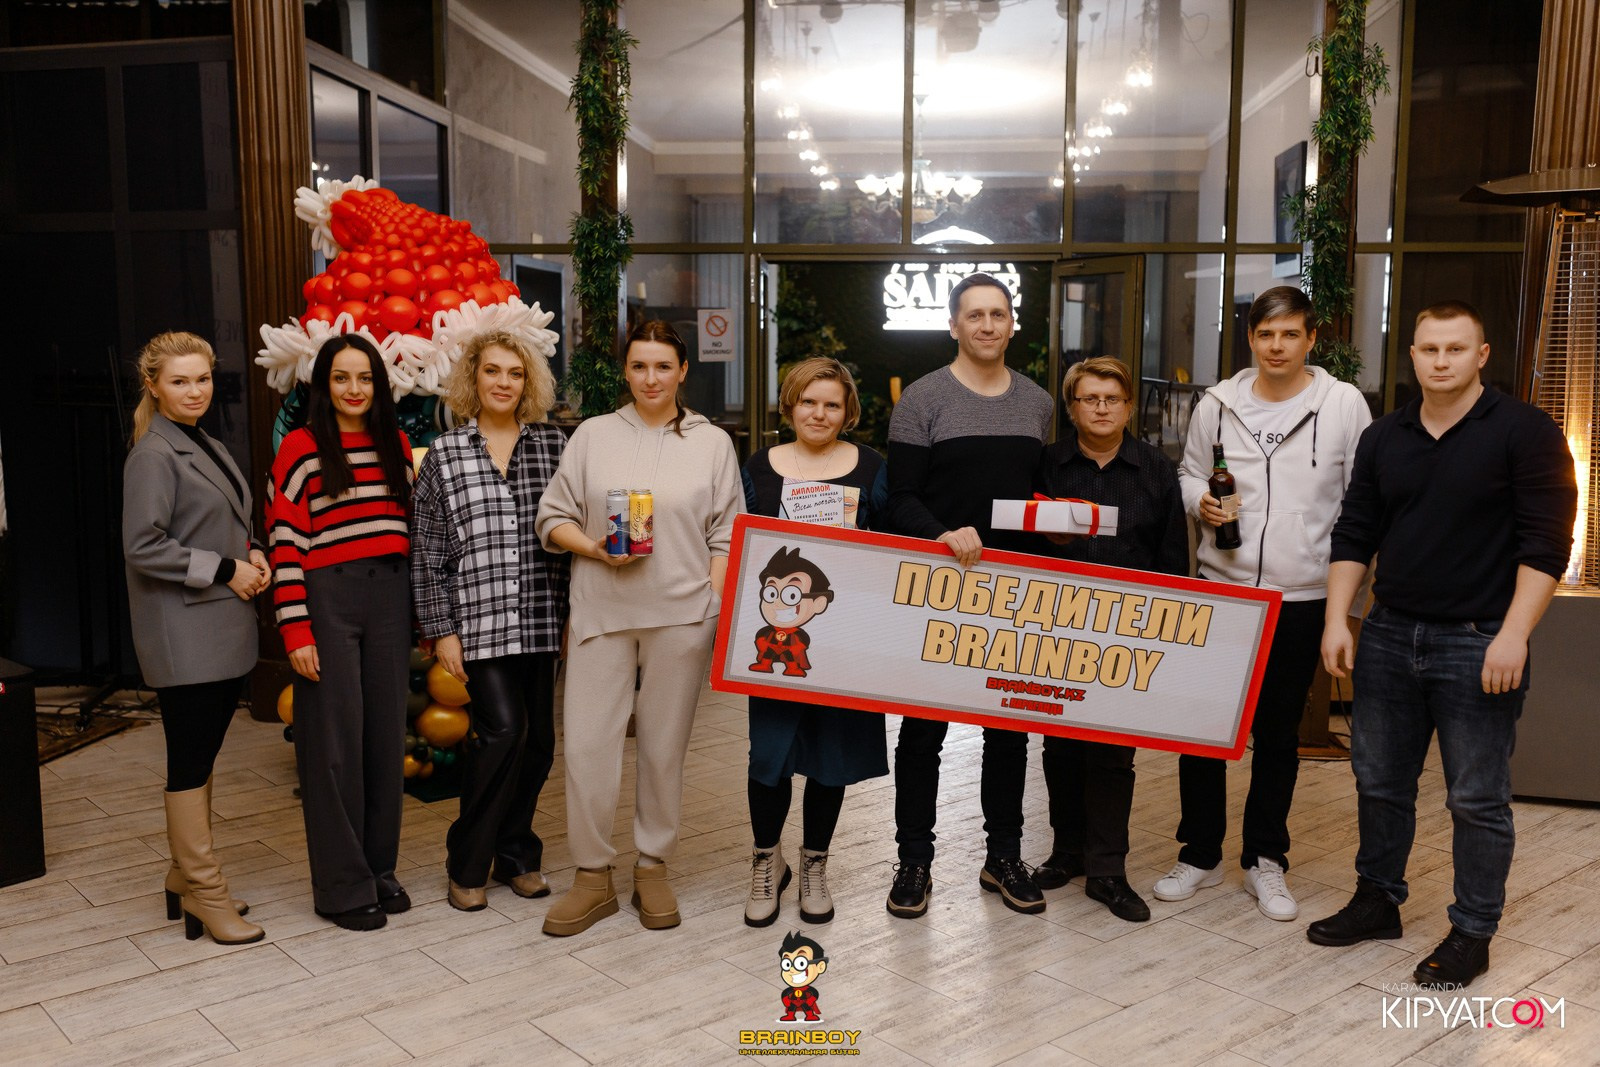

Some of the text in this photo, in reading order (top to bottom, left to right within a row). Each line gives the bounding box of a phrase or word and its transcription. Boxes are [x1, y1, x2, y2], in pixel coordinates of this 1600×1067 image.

[791, 485, 830, 496] ДИПЛОМОМ
[892, 561, 1213, 647] ПОБЕДИТЕЛИ
[921, 619, 1164, 692] BRAINBOY
[986, 677, 1086, 701] BRAINBOY.KZ
